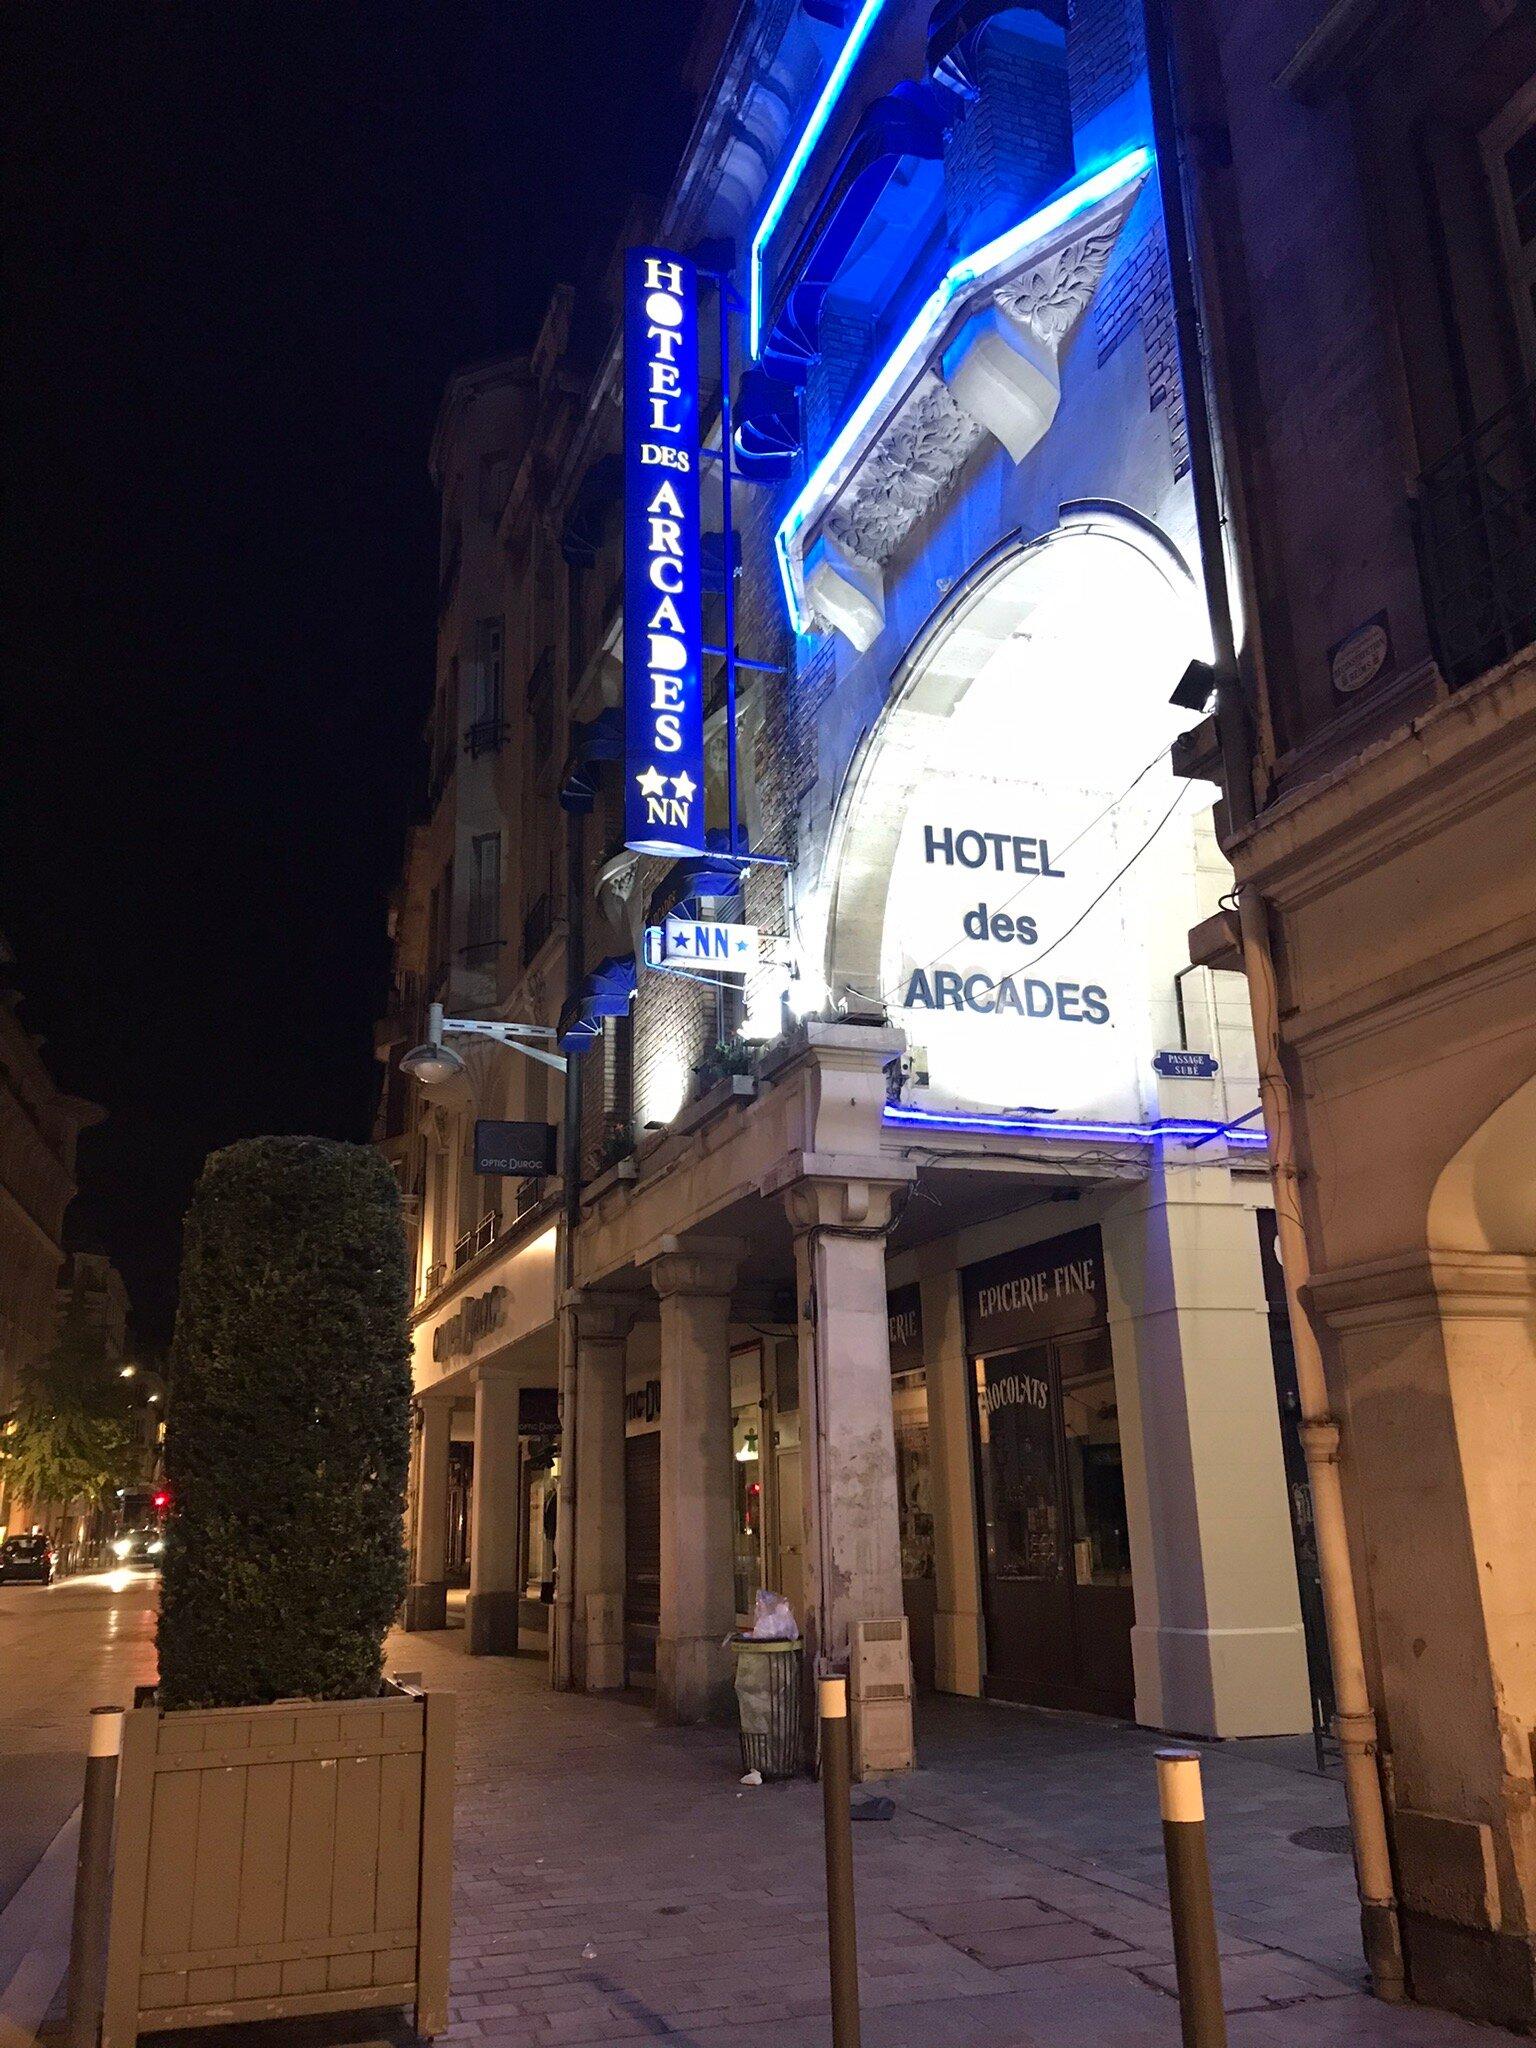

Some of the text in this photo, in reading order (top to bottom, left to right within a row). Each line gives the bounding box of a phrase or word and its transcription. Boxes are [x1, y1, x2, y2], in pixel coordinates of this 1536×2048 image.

[640, 259, 690, 752] HOTEL DES ARCADES
[646, 796, 690, 829] NN
[924, 825, 1065, 878] HOTEL
[695, 926, 729, 958] NN
[963, 902, 1038, 945] des
[903, 968, 1110, 1025] ARCADES
[1168, 1054, 1204, 1065] PASSAGE
[978, 1258, 1096, 1318] EPICERIE FINE
